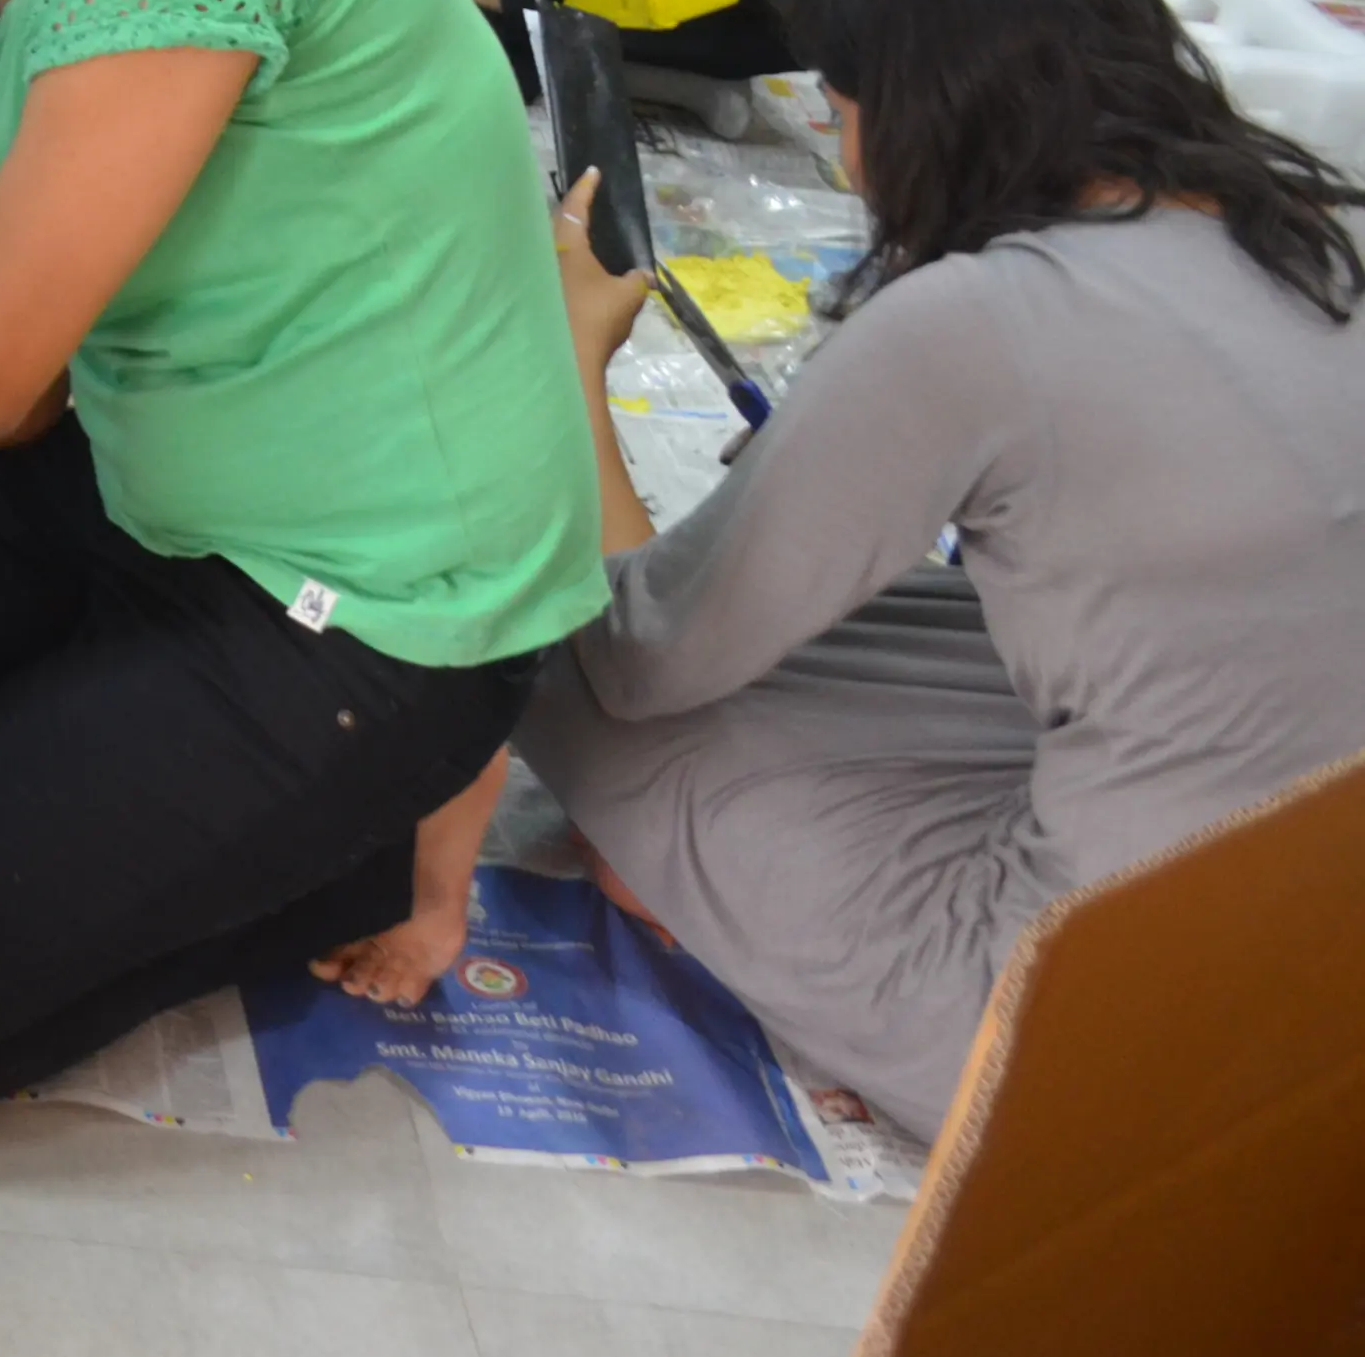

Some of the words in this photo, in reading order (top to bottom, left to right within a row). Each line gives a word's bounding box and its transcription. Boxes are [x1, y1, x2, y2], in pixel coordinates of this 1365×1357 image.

[431, 1011, 510, 1026] Bachao
[514, 1012, 557, 1029] Beti
[561, 1016, 639, 1046] Padhao
[376, 1042, 426, 1058] Smt.
[432, 1045, 519, 1067] Maneka
[522, 1052, 592, 1082] Sanjay
[595, 1067, 674, 1086] Gandhi
